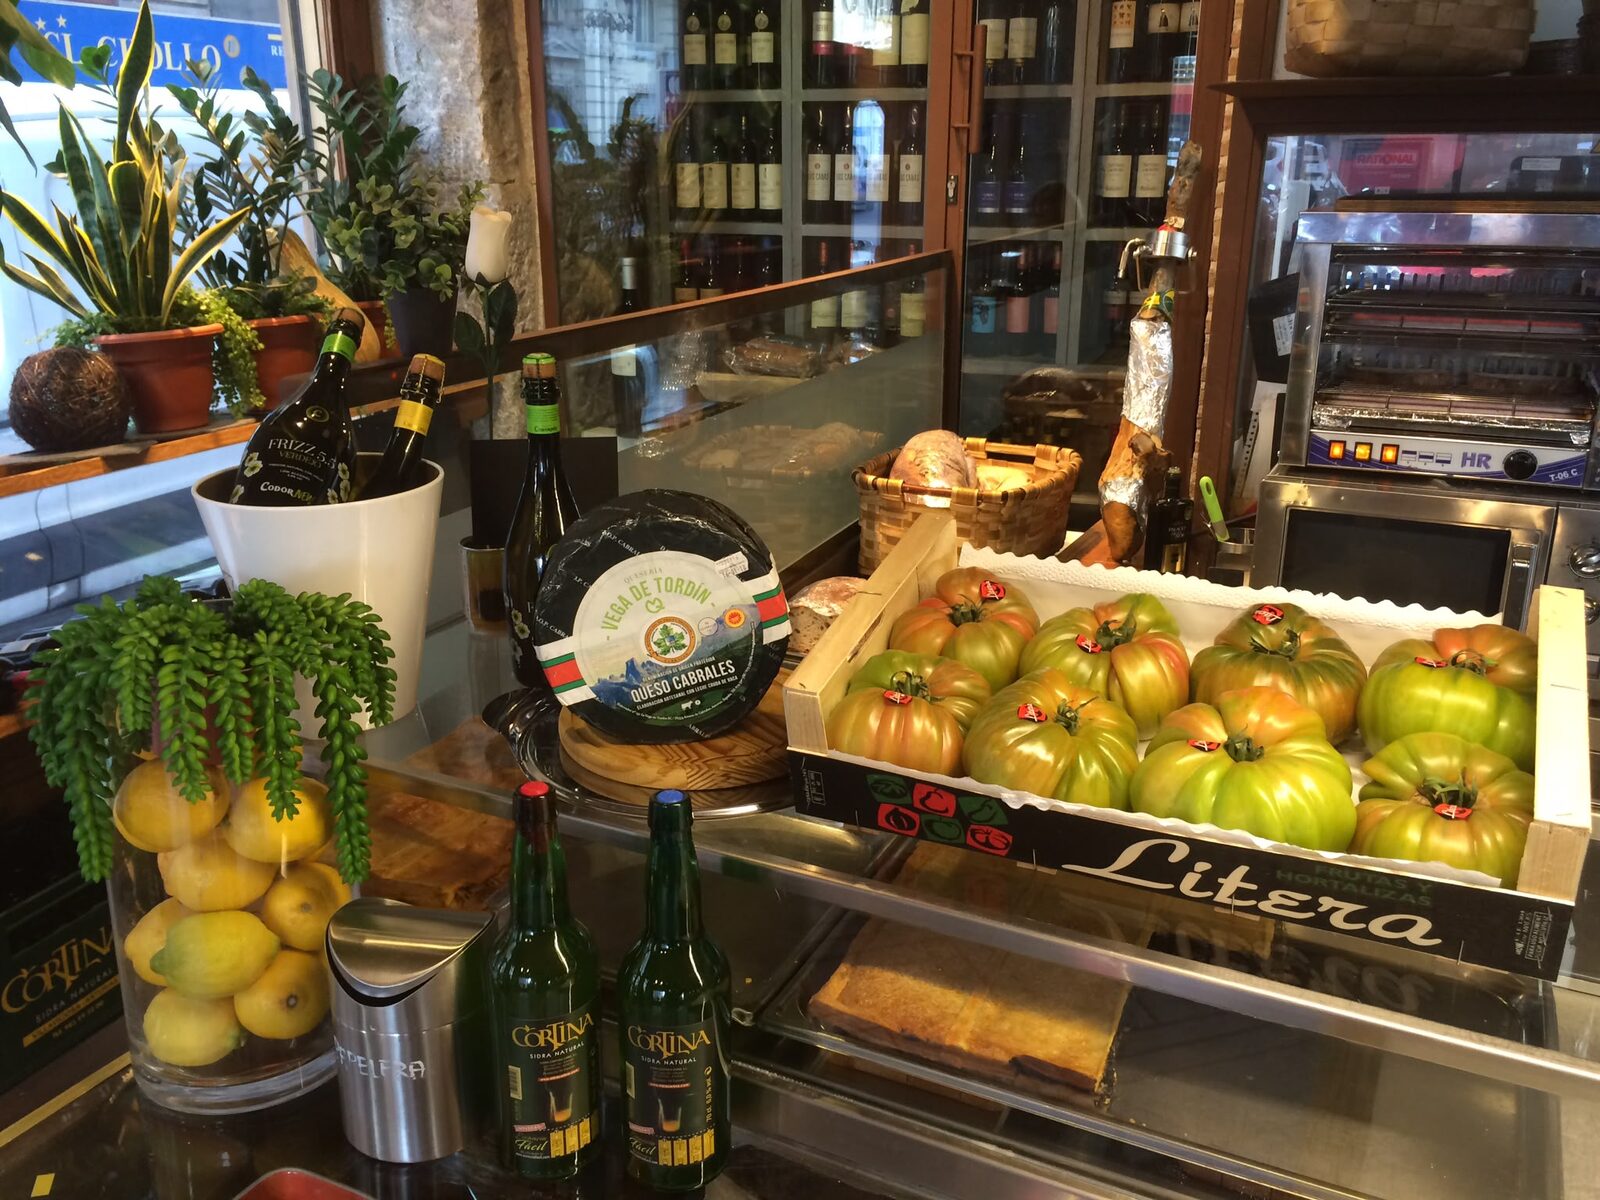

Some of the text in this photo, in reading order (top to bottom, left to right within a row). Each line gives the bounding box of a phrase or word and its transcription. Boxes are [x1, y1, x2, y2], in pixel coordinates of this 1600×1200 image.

[1357, 153, 1417, 165] RATIONAL
[268, 438, 316, 456] FRIZZ
[1461, 452, 1492, 470] HR
[1548, 468, 1578, 482] T-06 C
[601, 576, 712, 630] VEGA DE TORDÍN
[630, 659, 736, 703] QUESO CABRALES
[1061, 838, 1443, 947] Litera
[1275, 869, 1433, 907] HORTALIZAS
[1314, 863, 1434, 894] FRUTAS Y
[511, 1012, 594, 1051] CORTINA
[627, 1025, 712, 1059] CORTINA
[529, 1041, 585, 1060] SIDRA NATURAL
[641, 1055, 697, 1066] SIDRA NATURAL
